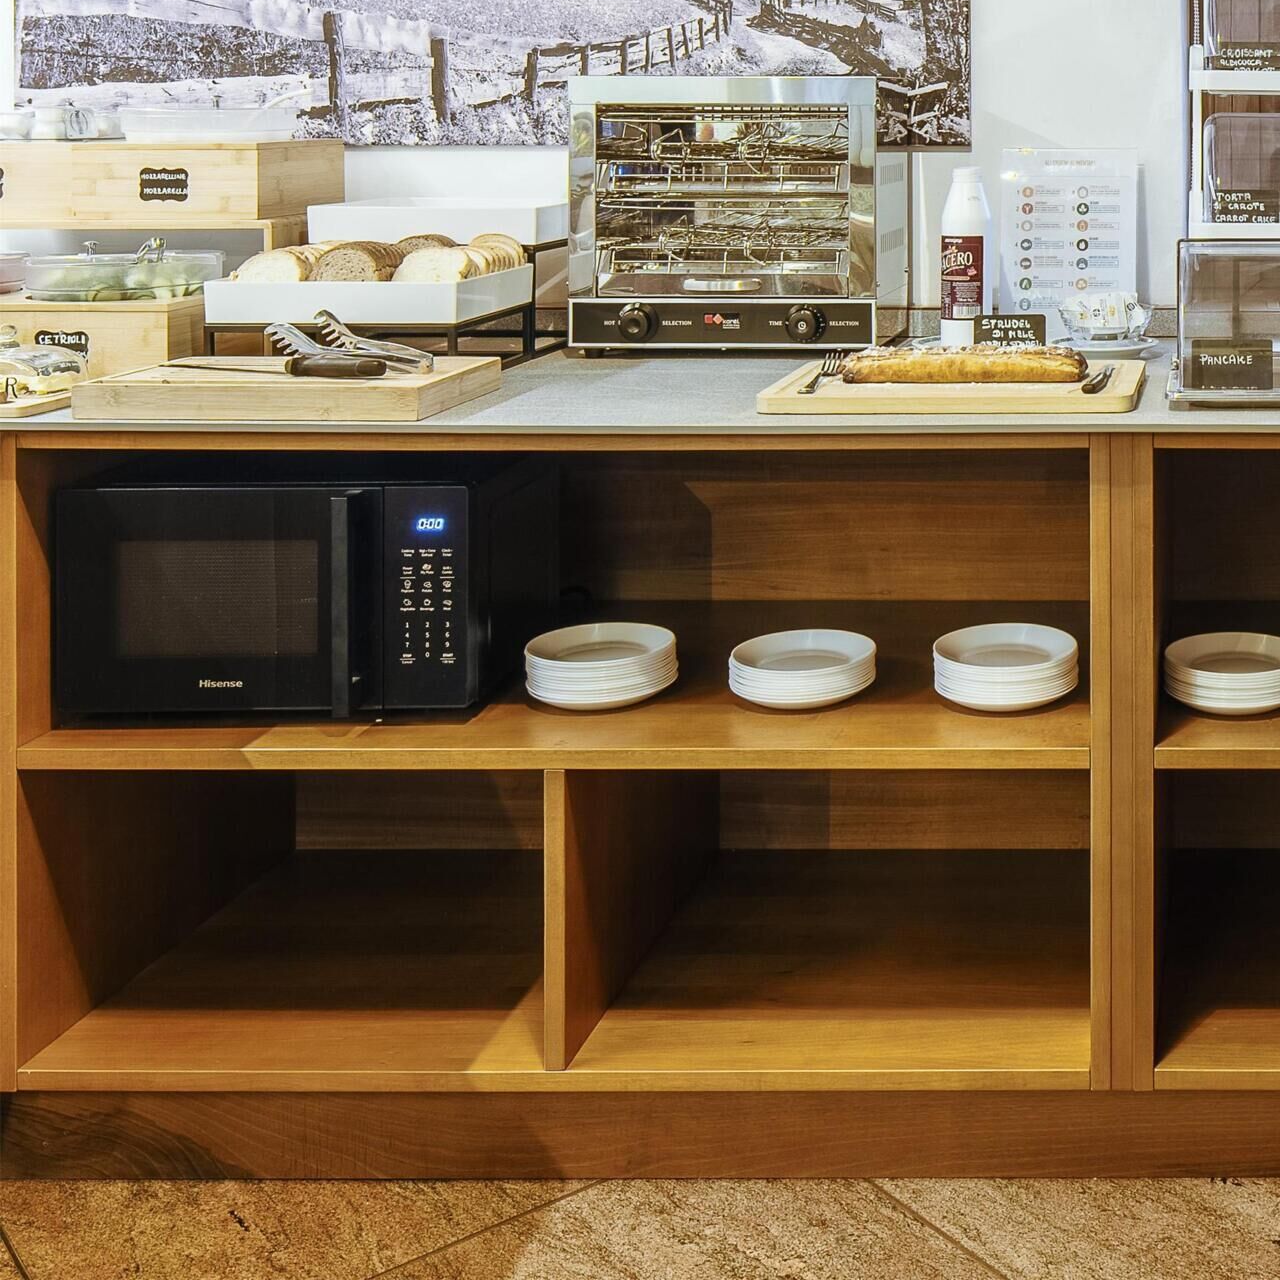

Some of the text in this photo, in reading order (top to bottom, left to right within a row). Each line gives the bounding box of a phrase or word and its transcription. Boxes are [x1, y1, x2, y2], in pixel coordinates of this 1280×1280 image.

[1216, 192, 1252, 202] TORTA
[1228, 202, 1265, 211] CAROTE
[1215, 214, 1248, 222] CARROT
[982, 318, 1031, 330] STRUDEL
[992, 329, 1004, 338] DI
[38, 334, 86, 344] CETRIOLI
[1200, 353, 1253, 365] PANCAKE
[417, 518, 444, 531] 0:00
[199, 680, 243, 688] Hisense
